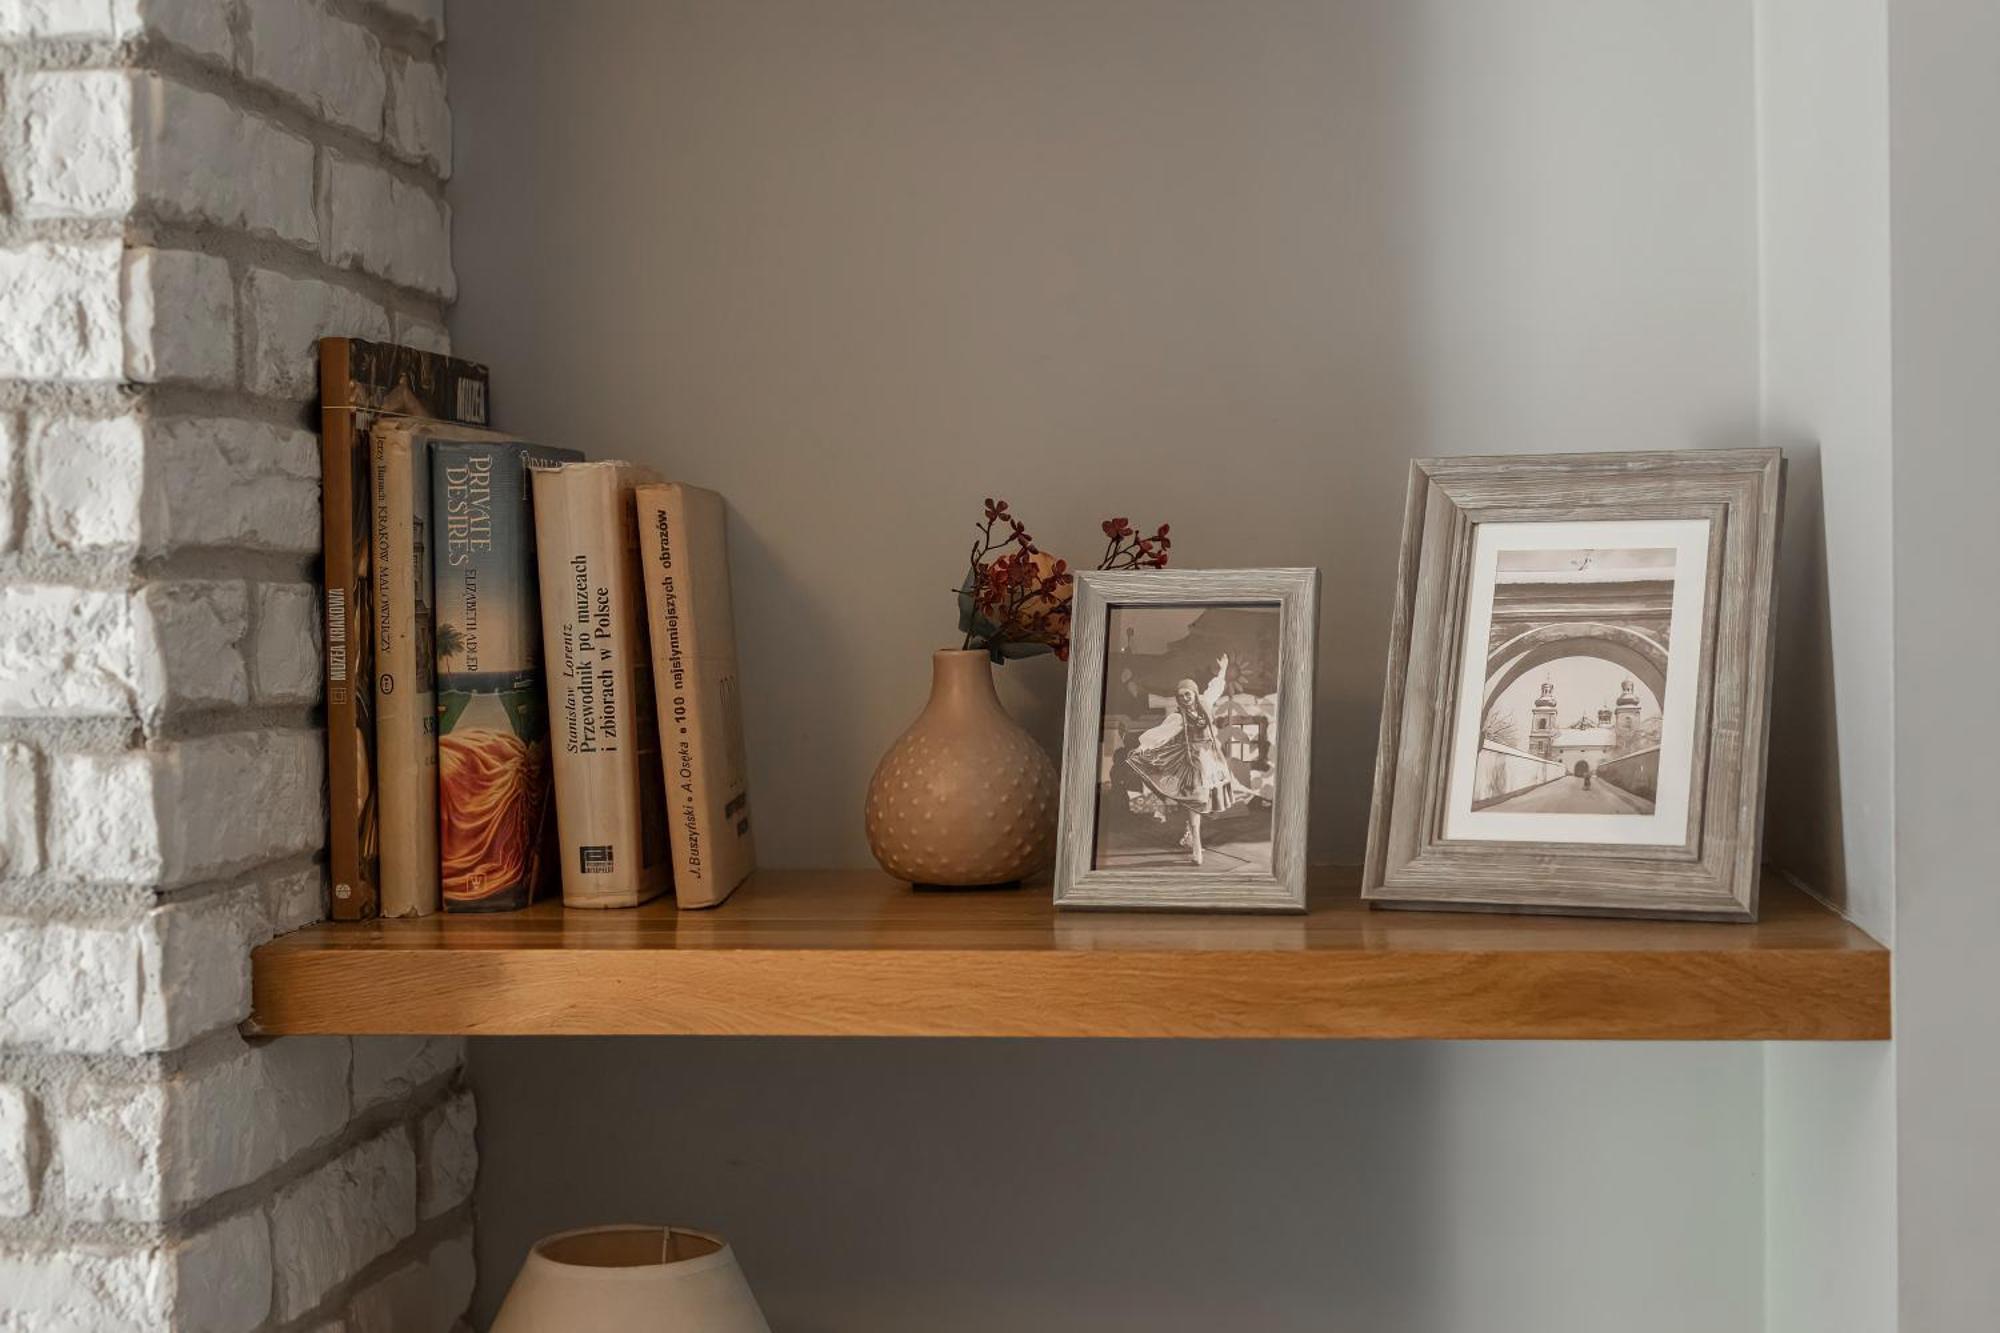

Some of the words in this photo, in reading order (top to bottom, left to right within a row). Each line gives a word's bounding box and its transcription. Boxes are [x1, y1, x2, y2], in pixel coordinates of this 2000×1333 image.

[376, 436, 387, 461] Jerzy
[445, 466, 470, 567] DESIRES
[468, 453, 493, 552] PRIVATE
[656, 510, 672, 569] obrazów
[328, 588, 346, 642] KRAKOWA
[463, 568, 478, 631] ELIZABETH
[570, 555, 593, 624] muzeach
[594, 587, 612, 638] Polsce
[465, 633, 479, 673] ADLER
[562, 624, 574, 678] Lorentz
[577, 632, 596, 652] po
[600, 648, 612, 661] w
[662, 576, 684, 690] najsłynniejszych
[330, 645, 346, 681] MUZEA
[575, 661, 597, 753] Przewodnik
[597, 669, 617, 738] zbiorach
[672, 697, 686, 724] 100
[600, 744, 617, 752] i
[679, 742, 694, 793] A.Osęka
[682, 806, 702, 879] J.Buszyński
